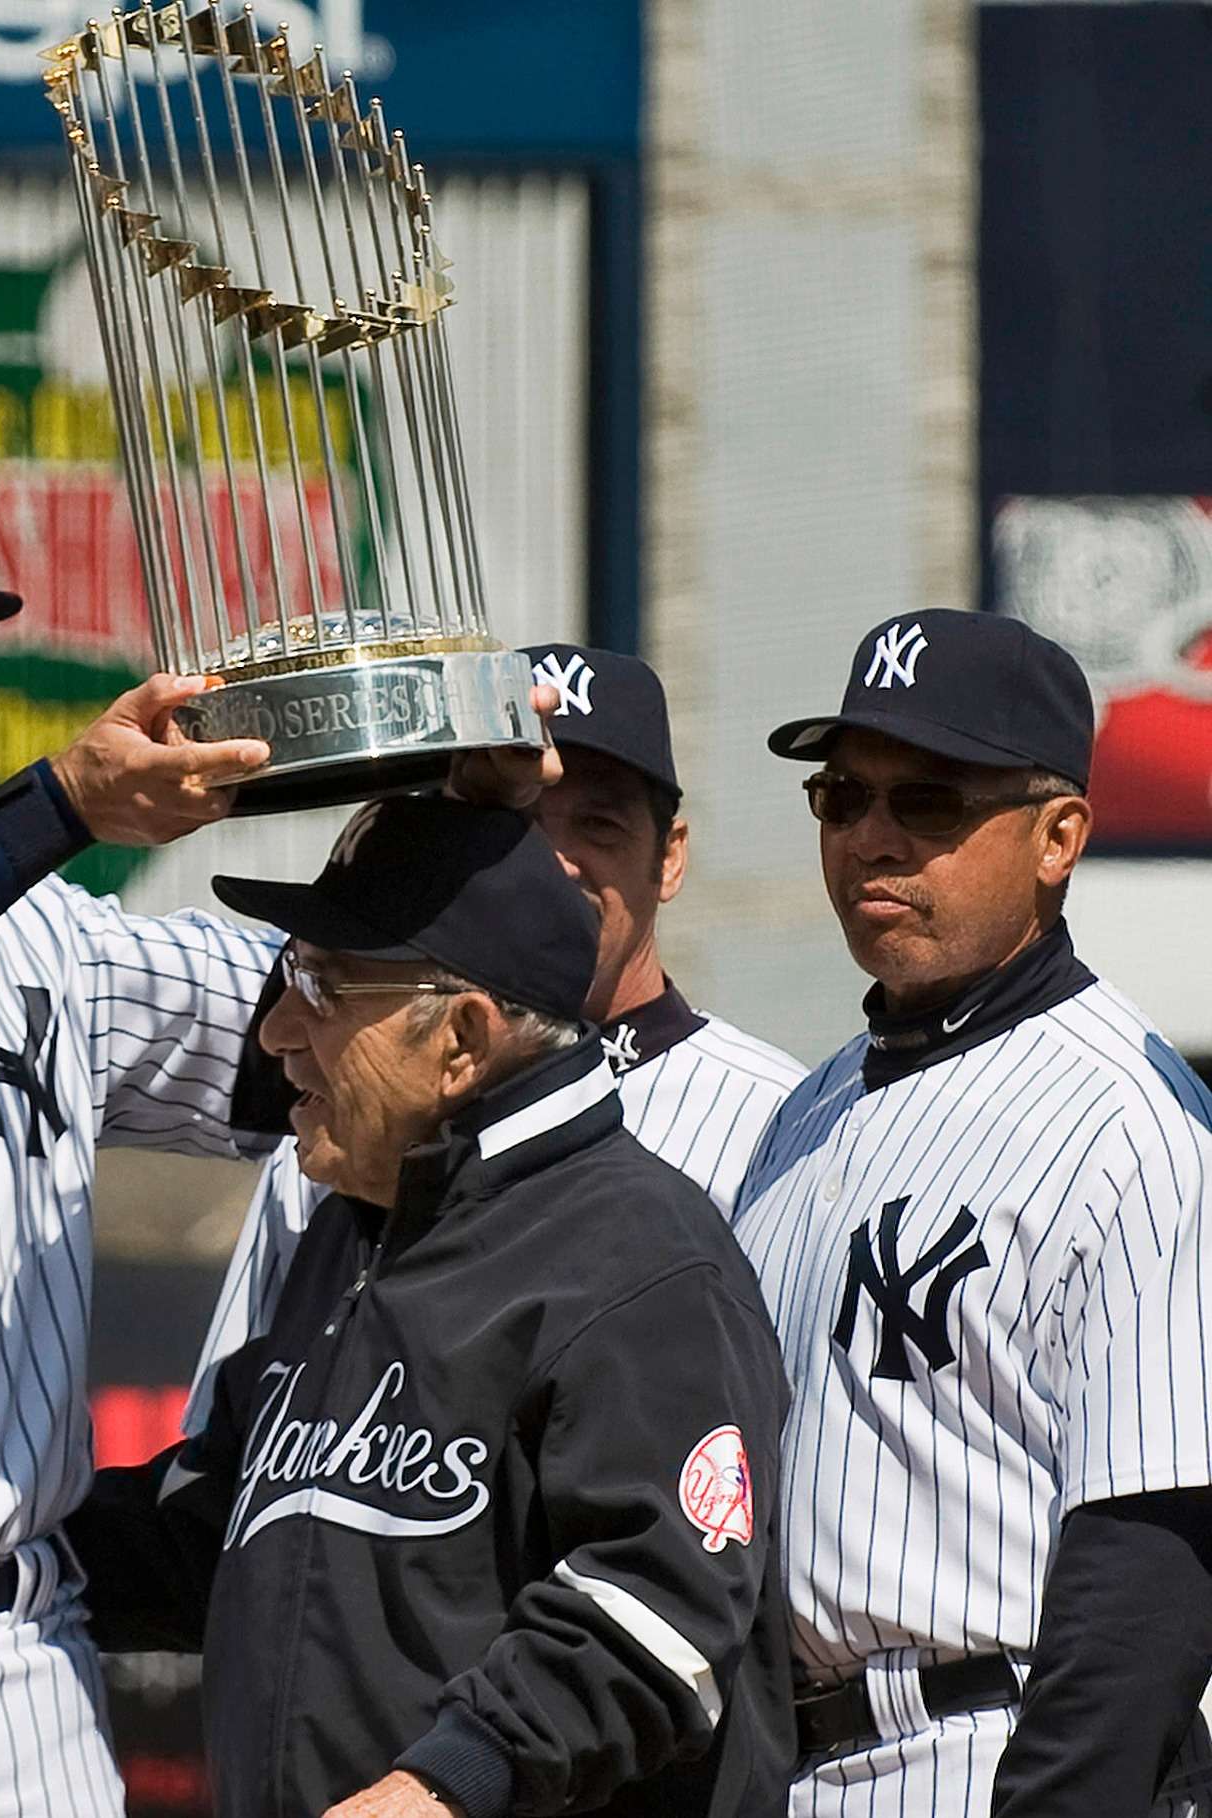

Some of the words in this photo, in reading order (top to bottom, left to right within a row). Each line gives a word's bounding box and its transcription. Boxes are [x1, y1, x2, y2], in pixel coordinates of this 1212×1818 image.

[531, 652, 596, 716] NY
[863, 622, 929, 689] NY
[284, 682, 411, 738] SERIES
[600, 1023, 640, 1072] NY
[832, 1195, 991, 1383] NY
[224, 1360, 490, 1550] Yankees
